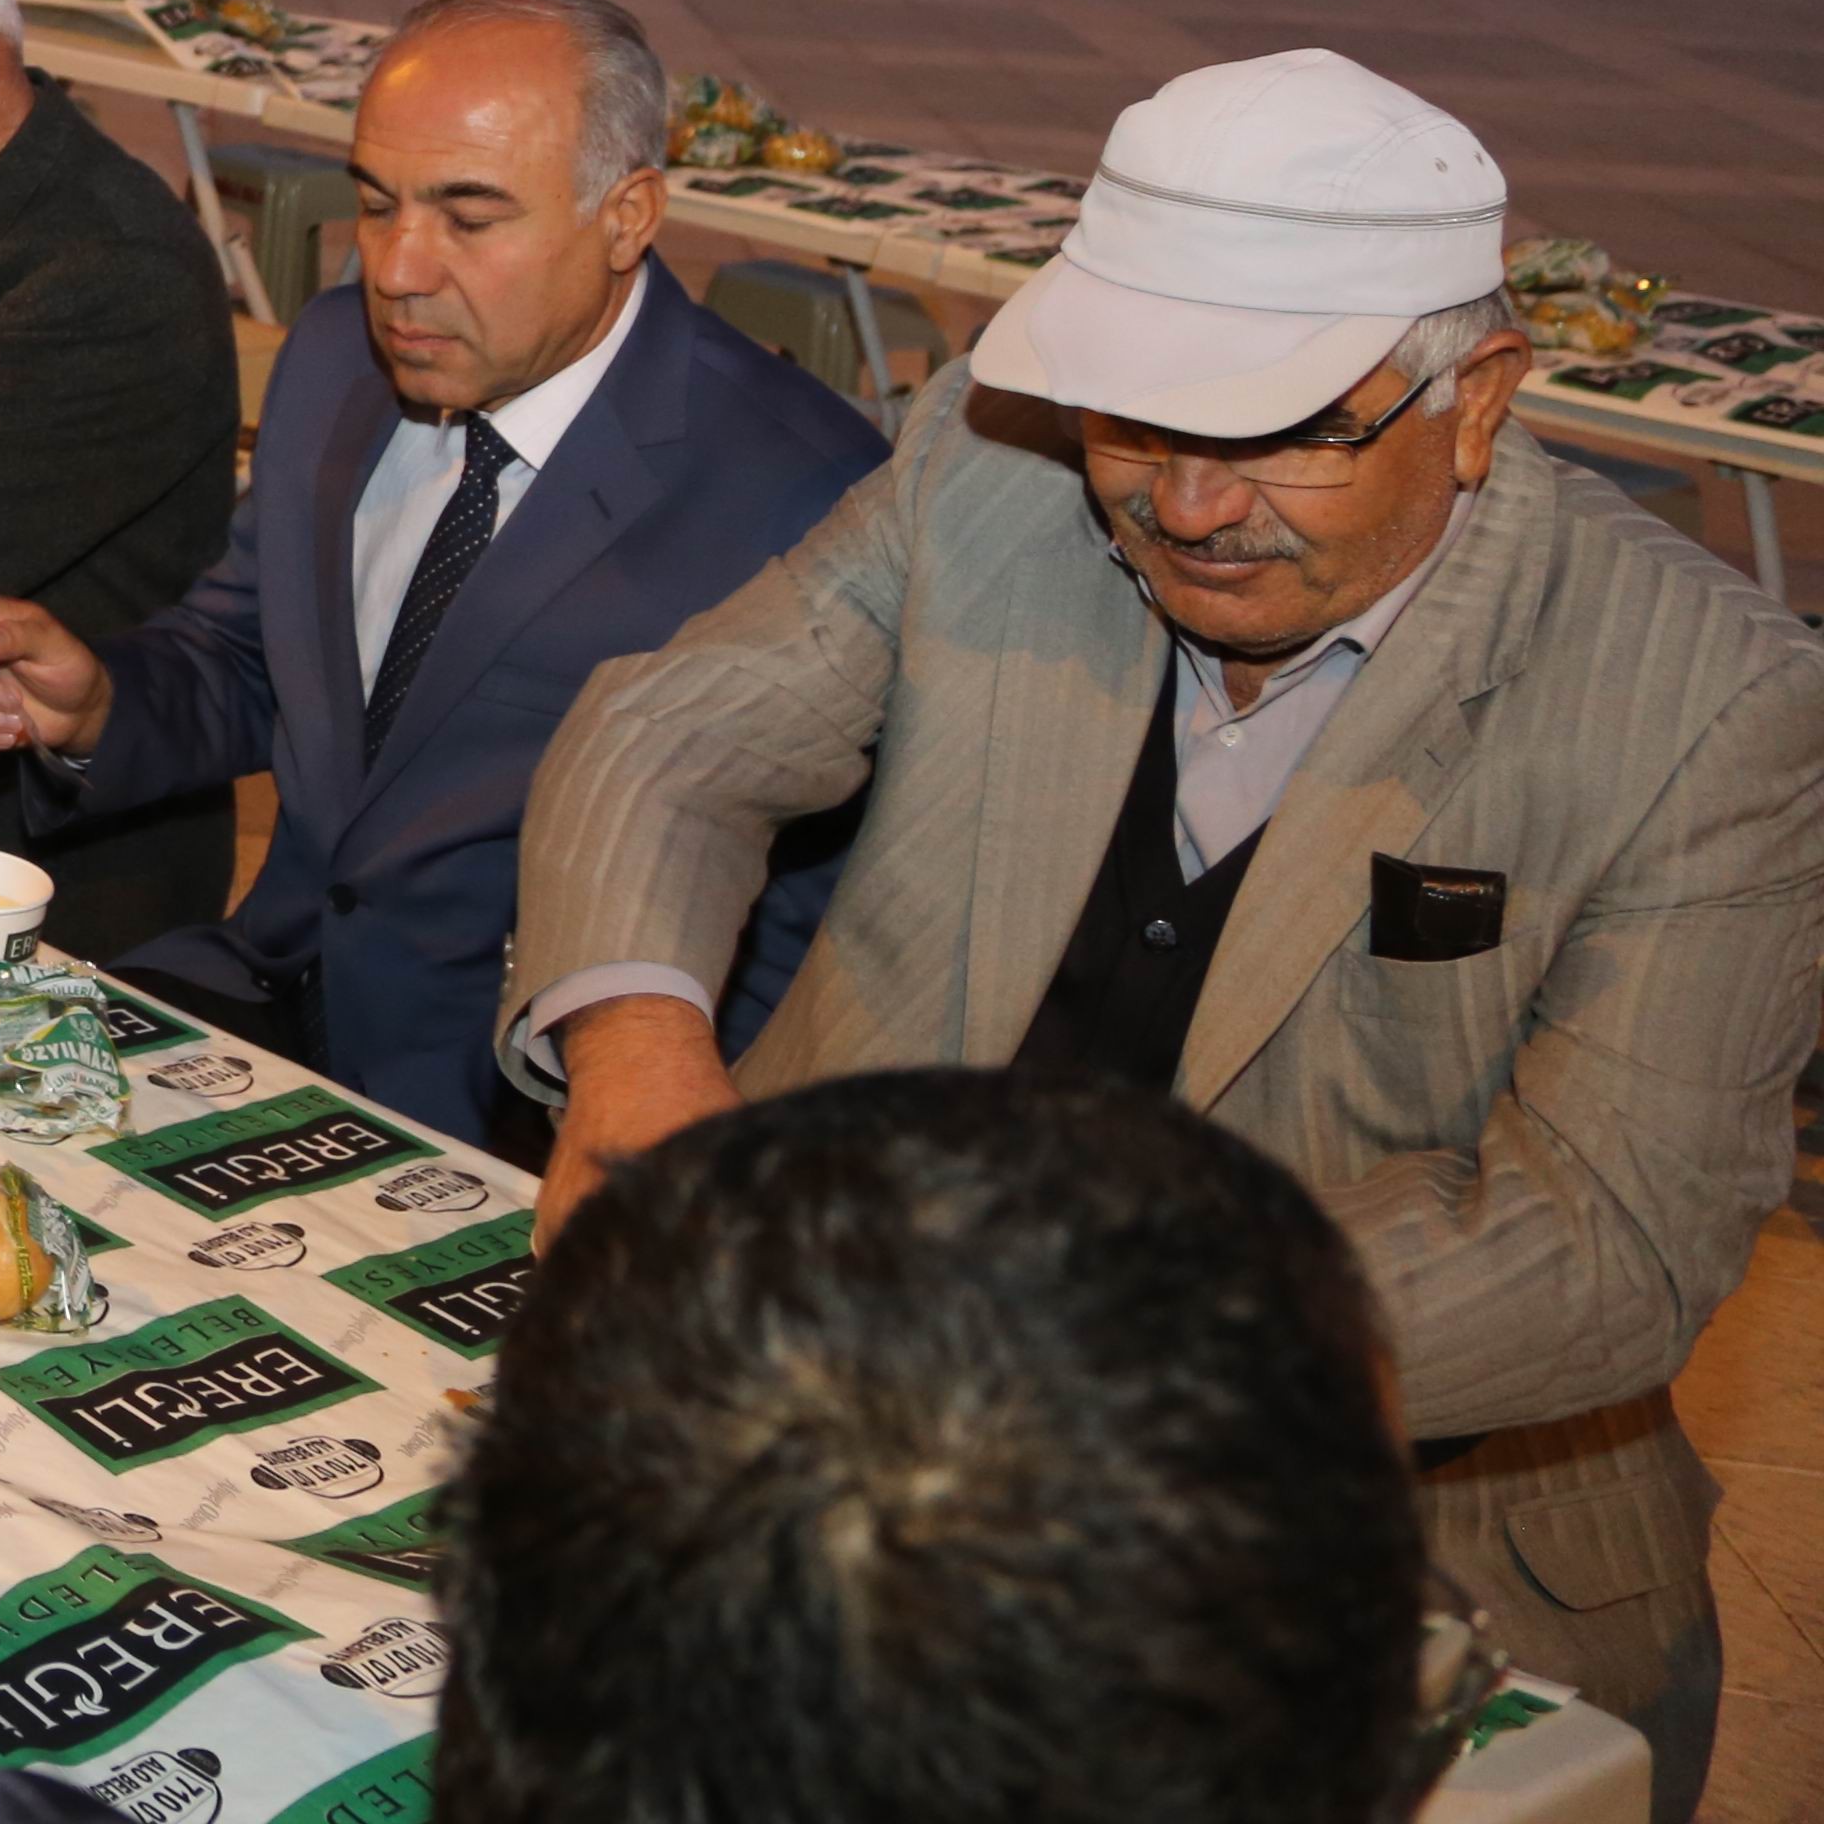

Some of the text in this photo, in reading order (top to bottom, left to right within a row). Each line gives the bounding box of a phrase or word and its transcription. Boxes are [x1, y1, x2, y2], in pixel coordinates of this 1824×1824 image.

[172, 1121, 391, 1201] EREĞLİ
[73, 1346, 327, 1450] EREĞLİ
[285, 1453, 369, 1488] 710 07 07
[361, 1658, 395, 1687] 07
[392, 1649, 418, 1674] 07
[158, 1776, 205, 1812] 710
